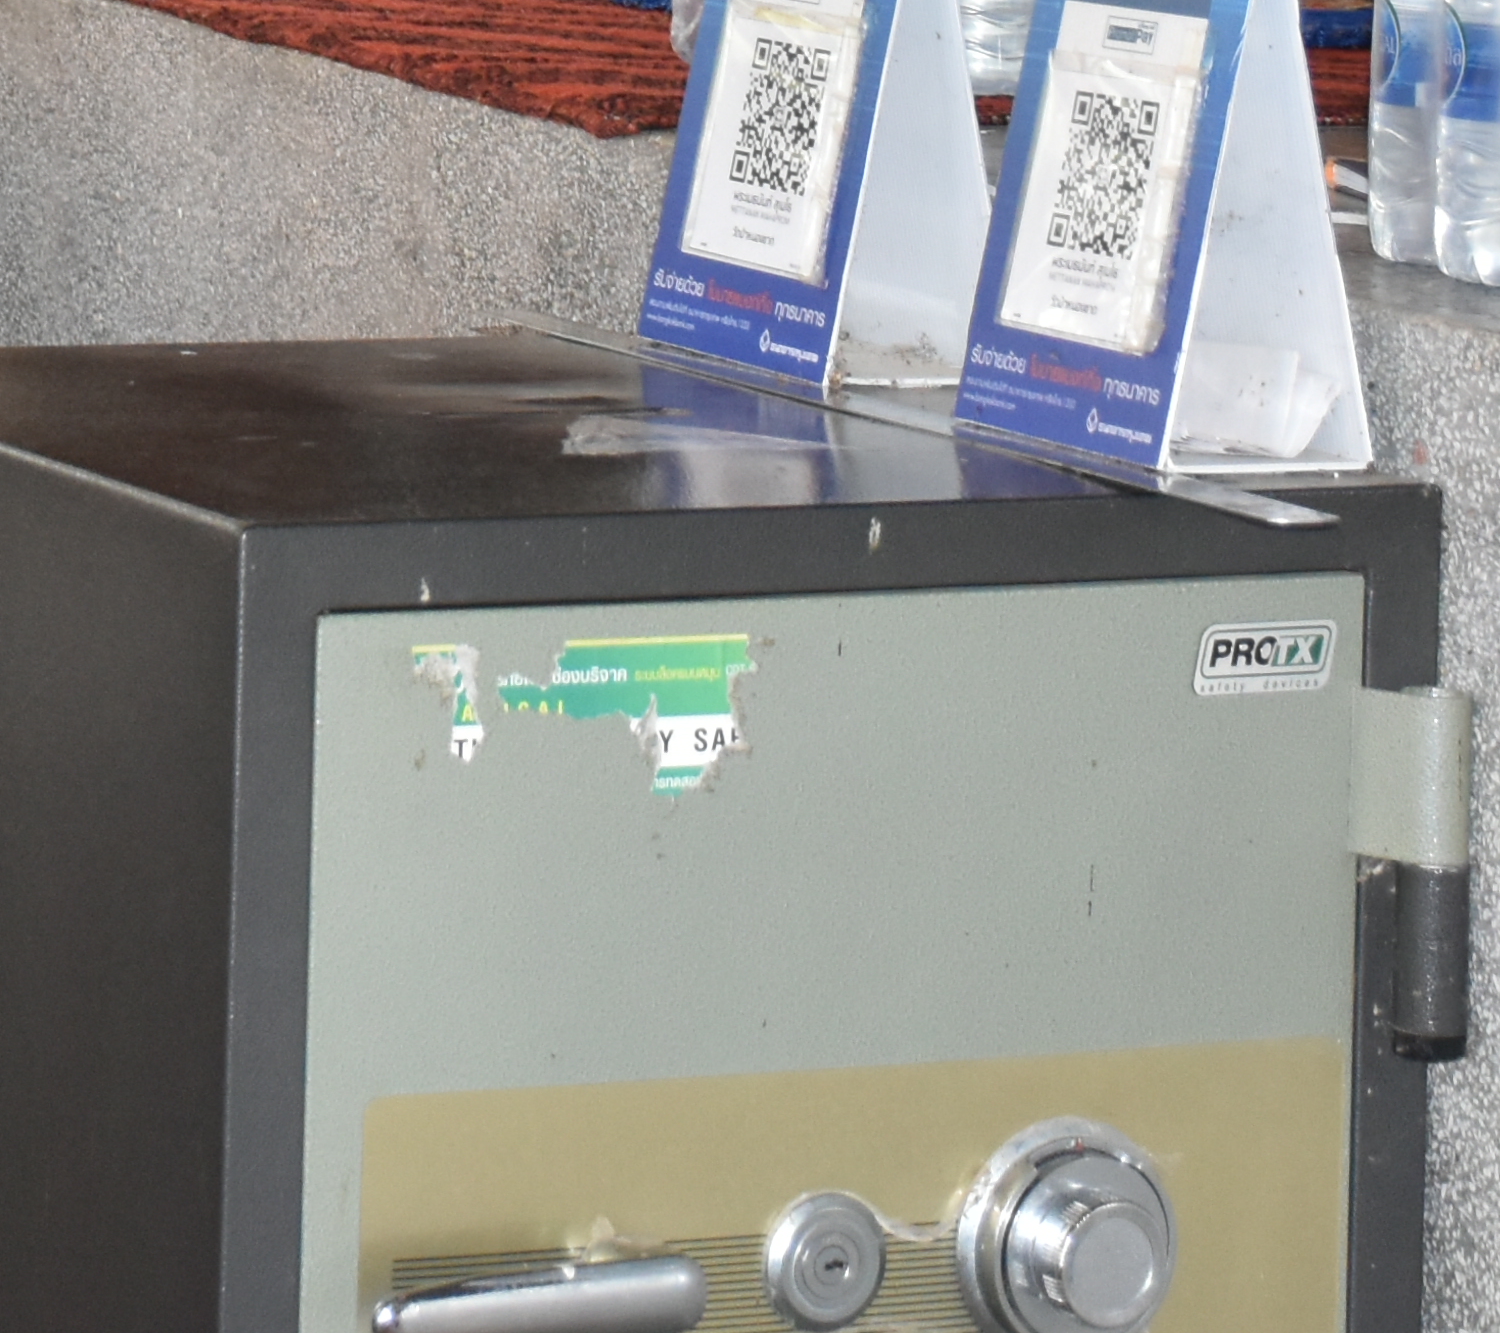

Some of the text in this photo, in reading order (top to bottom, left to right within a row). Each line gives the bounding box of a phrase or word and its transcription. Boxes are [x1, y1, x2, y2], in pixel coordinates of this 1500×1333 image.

[1209, 635, 1319, 668] PROTX
[1200, 678, 1319, 693] safety devices
